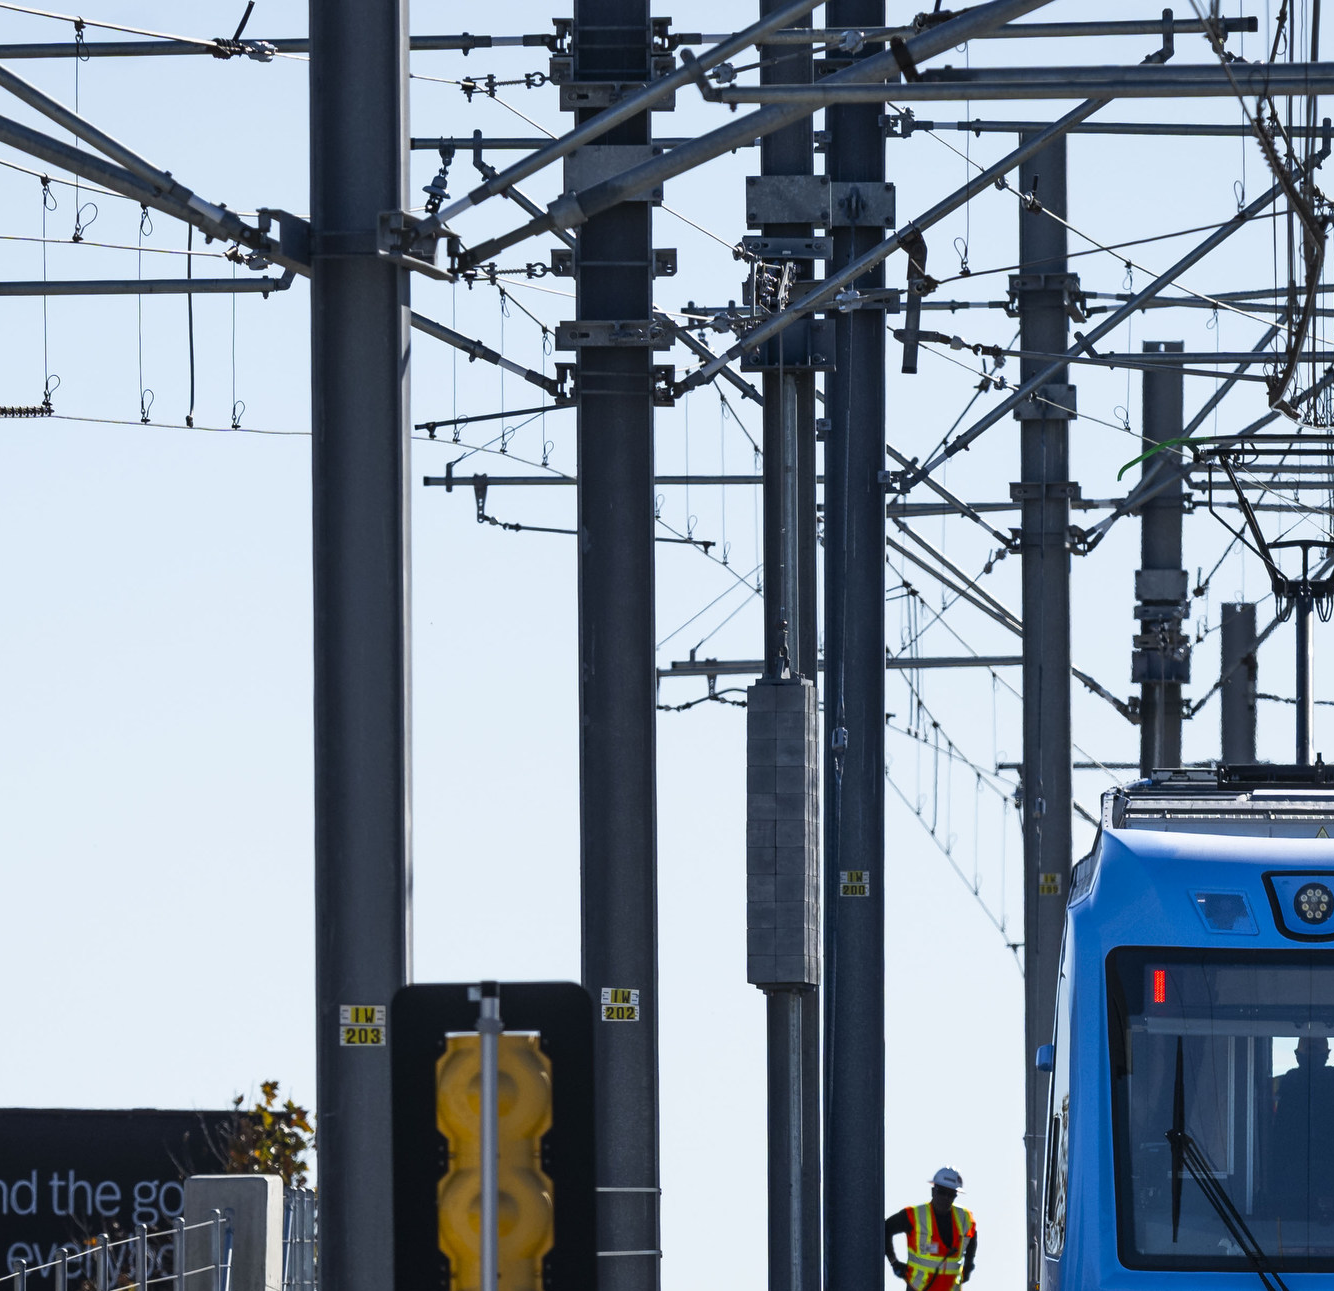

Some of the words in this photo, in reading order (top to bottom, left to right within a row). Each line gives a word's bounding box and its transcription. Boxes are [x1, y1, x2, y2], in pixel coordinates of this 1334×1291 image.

[842, 884, 866, 896] 200
[605, 1006, 635, 1020] 202
[345, 1027, 381, 1045] 203
[49, 1168, 122, 1217] the
